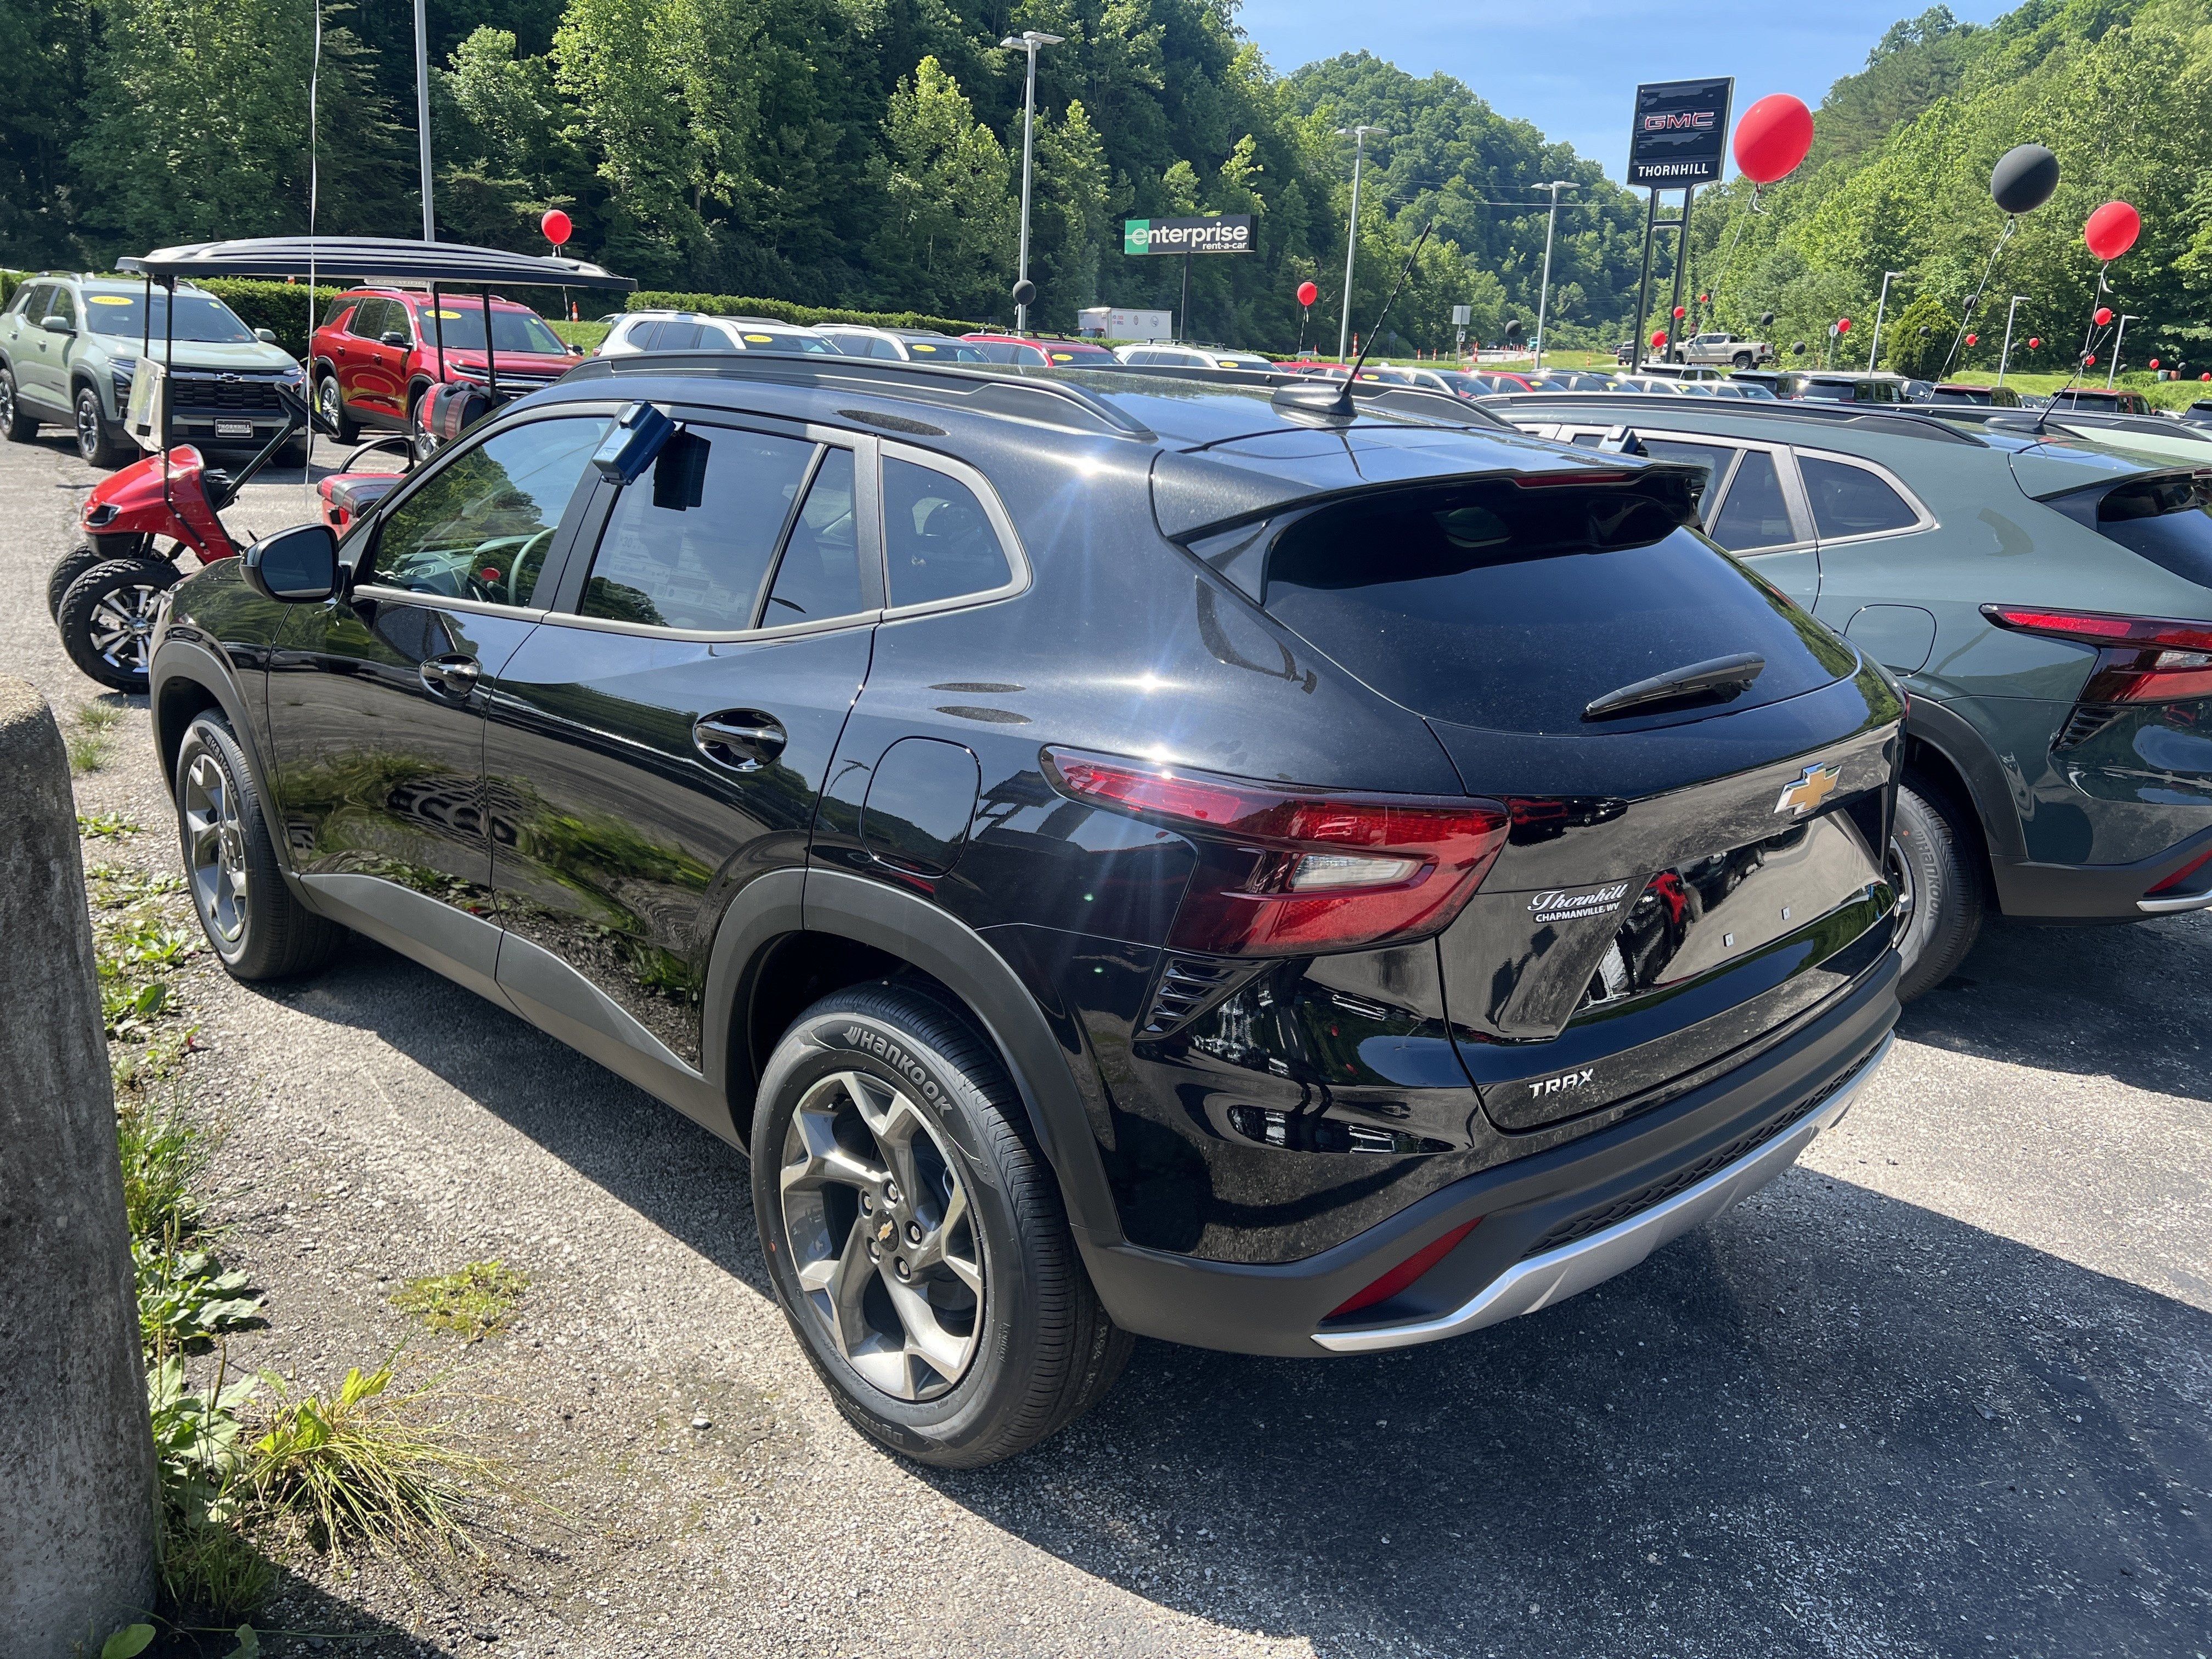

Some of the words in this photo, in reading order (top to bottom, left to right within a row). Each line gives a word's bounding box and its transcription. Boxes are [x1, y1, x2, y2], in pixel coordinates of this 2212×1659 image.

[1645, 112, 1714, 131] GMC
[1639, 163, 1708, 177] THORNHILL
[1127, 222, 1249, 247] enterprise
[1203, 241, 1247, 250] rent-a-car
[1527, 883, 1629, 911] Thornhill
[1606, 901, 1621, 912] WV
[1528, 1068, 1594, 1099] TRAX
